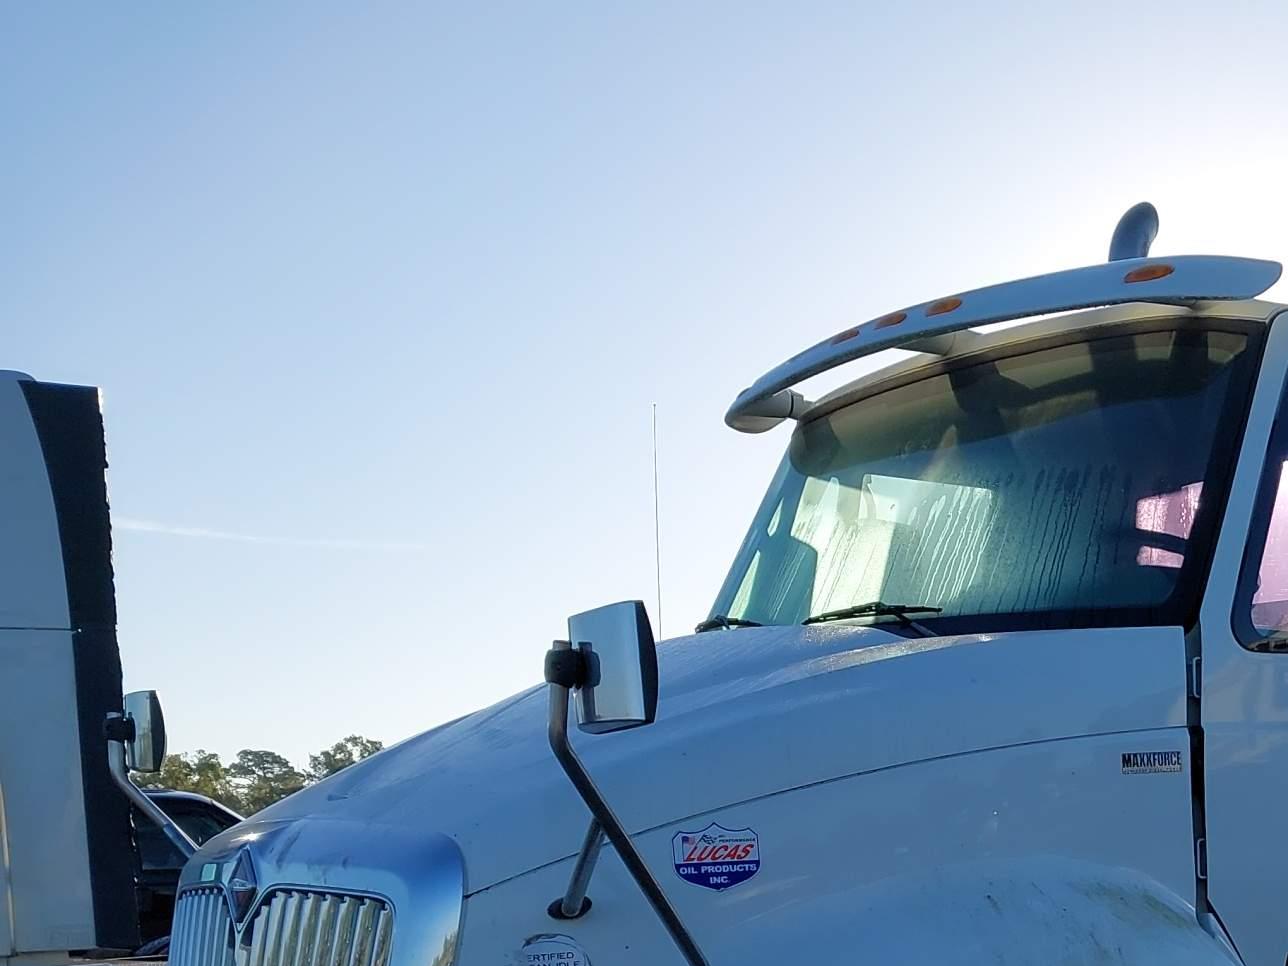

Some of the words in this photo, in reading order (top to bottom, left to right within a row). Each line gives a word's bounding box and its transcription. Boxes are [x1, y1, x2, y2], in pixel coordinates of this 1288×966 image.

[1121, 751, 1182, 768] MAXXFORCE
[683, 844, 754, 863] LUCAS
[679, 866, 698, 874] OIL
[701, 863, 757, 874] PRODUCTS
[527, 951, 575, 963] ERTIFIED
